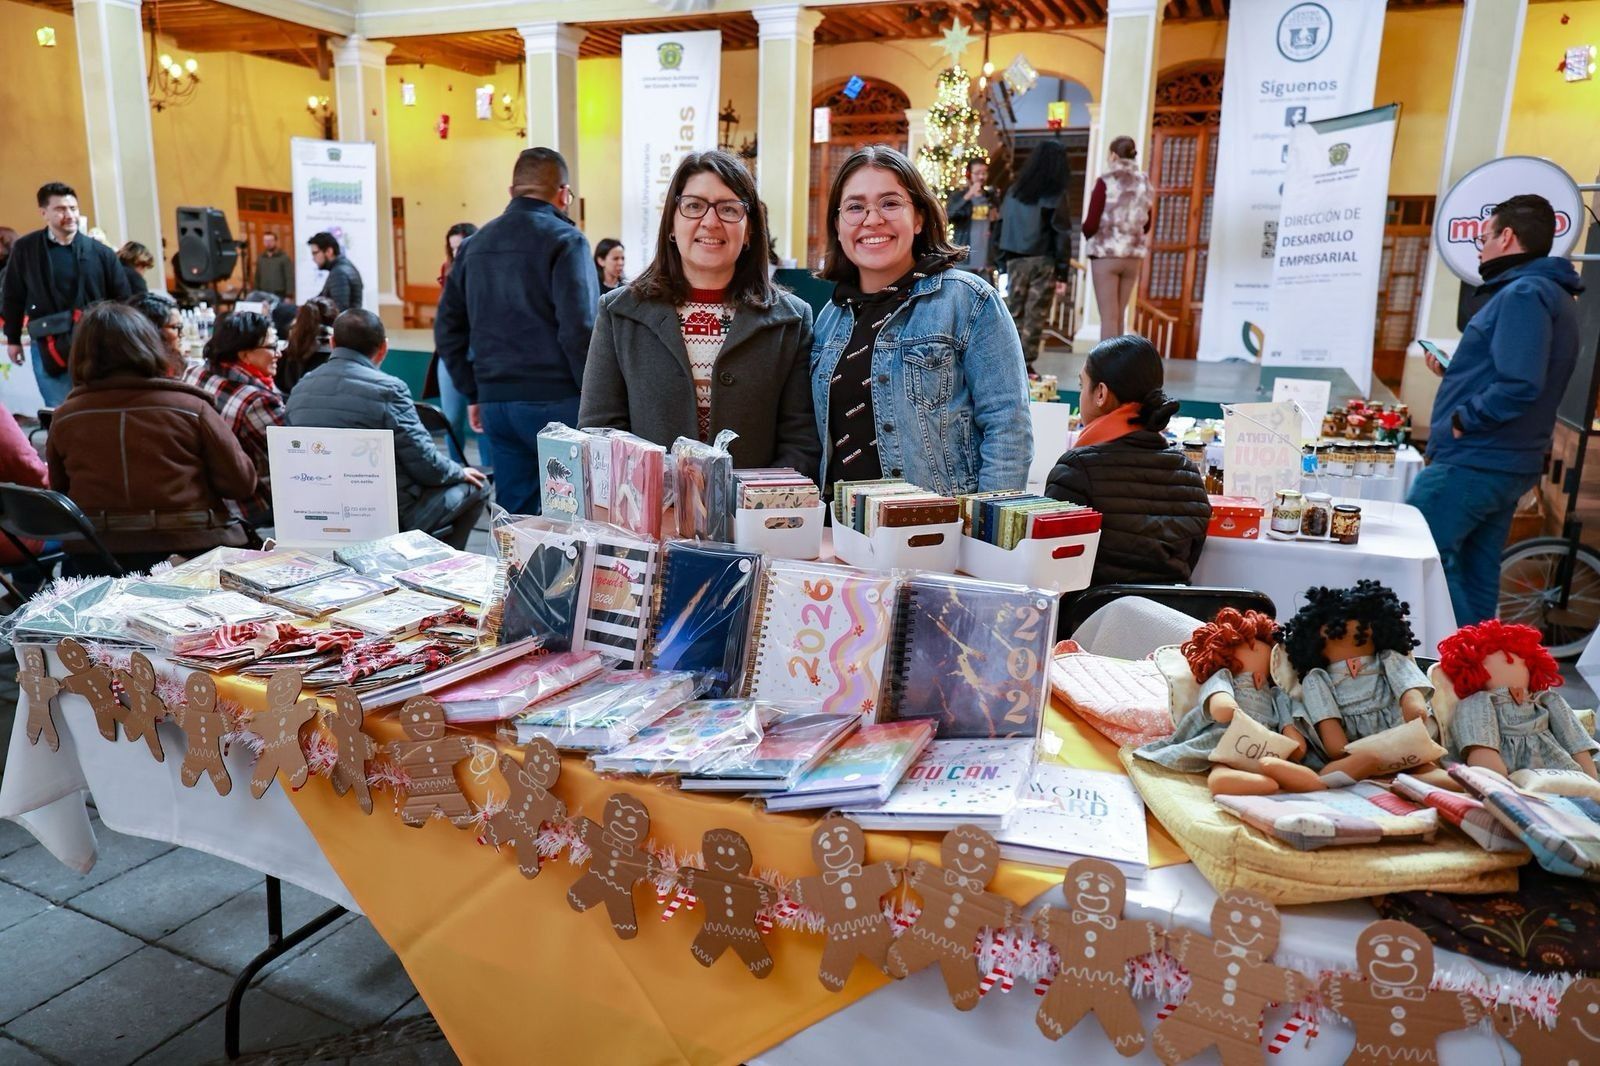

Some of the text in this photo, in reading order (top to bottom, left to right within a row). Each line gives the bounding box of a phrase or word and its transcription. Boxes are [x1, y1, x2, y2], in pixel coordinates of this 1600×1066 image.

[1260, 80, 1338, 97] Síguenos
[1284, 207, 1361, 228] DIRECCIÓN DE
[1282, 230, 1353, 247] DESARROLLO
[1279, 251, 1358, 268] EMPRESARIAL
[846, 344, 869, 360] KIRKLAND
[845, 402, 866, 417] KIRKLAND
[842, 448, 862, 464] KIRKLAND
[593, 591, 616, 606] 2026
[788, 577, 835, 686] 2026
[1003, 606, 1041, 739] 202
[908, 765, 999, 780] OU CAN
[1029, 782, 1107, 803] WORK
